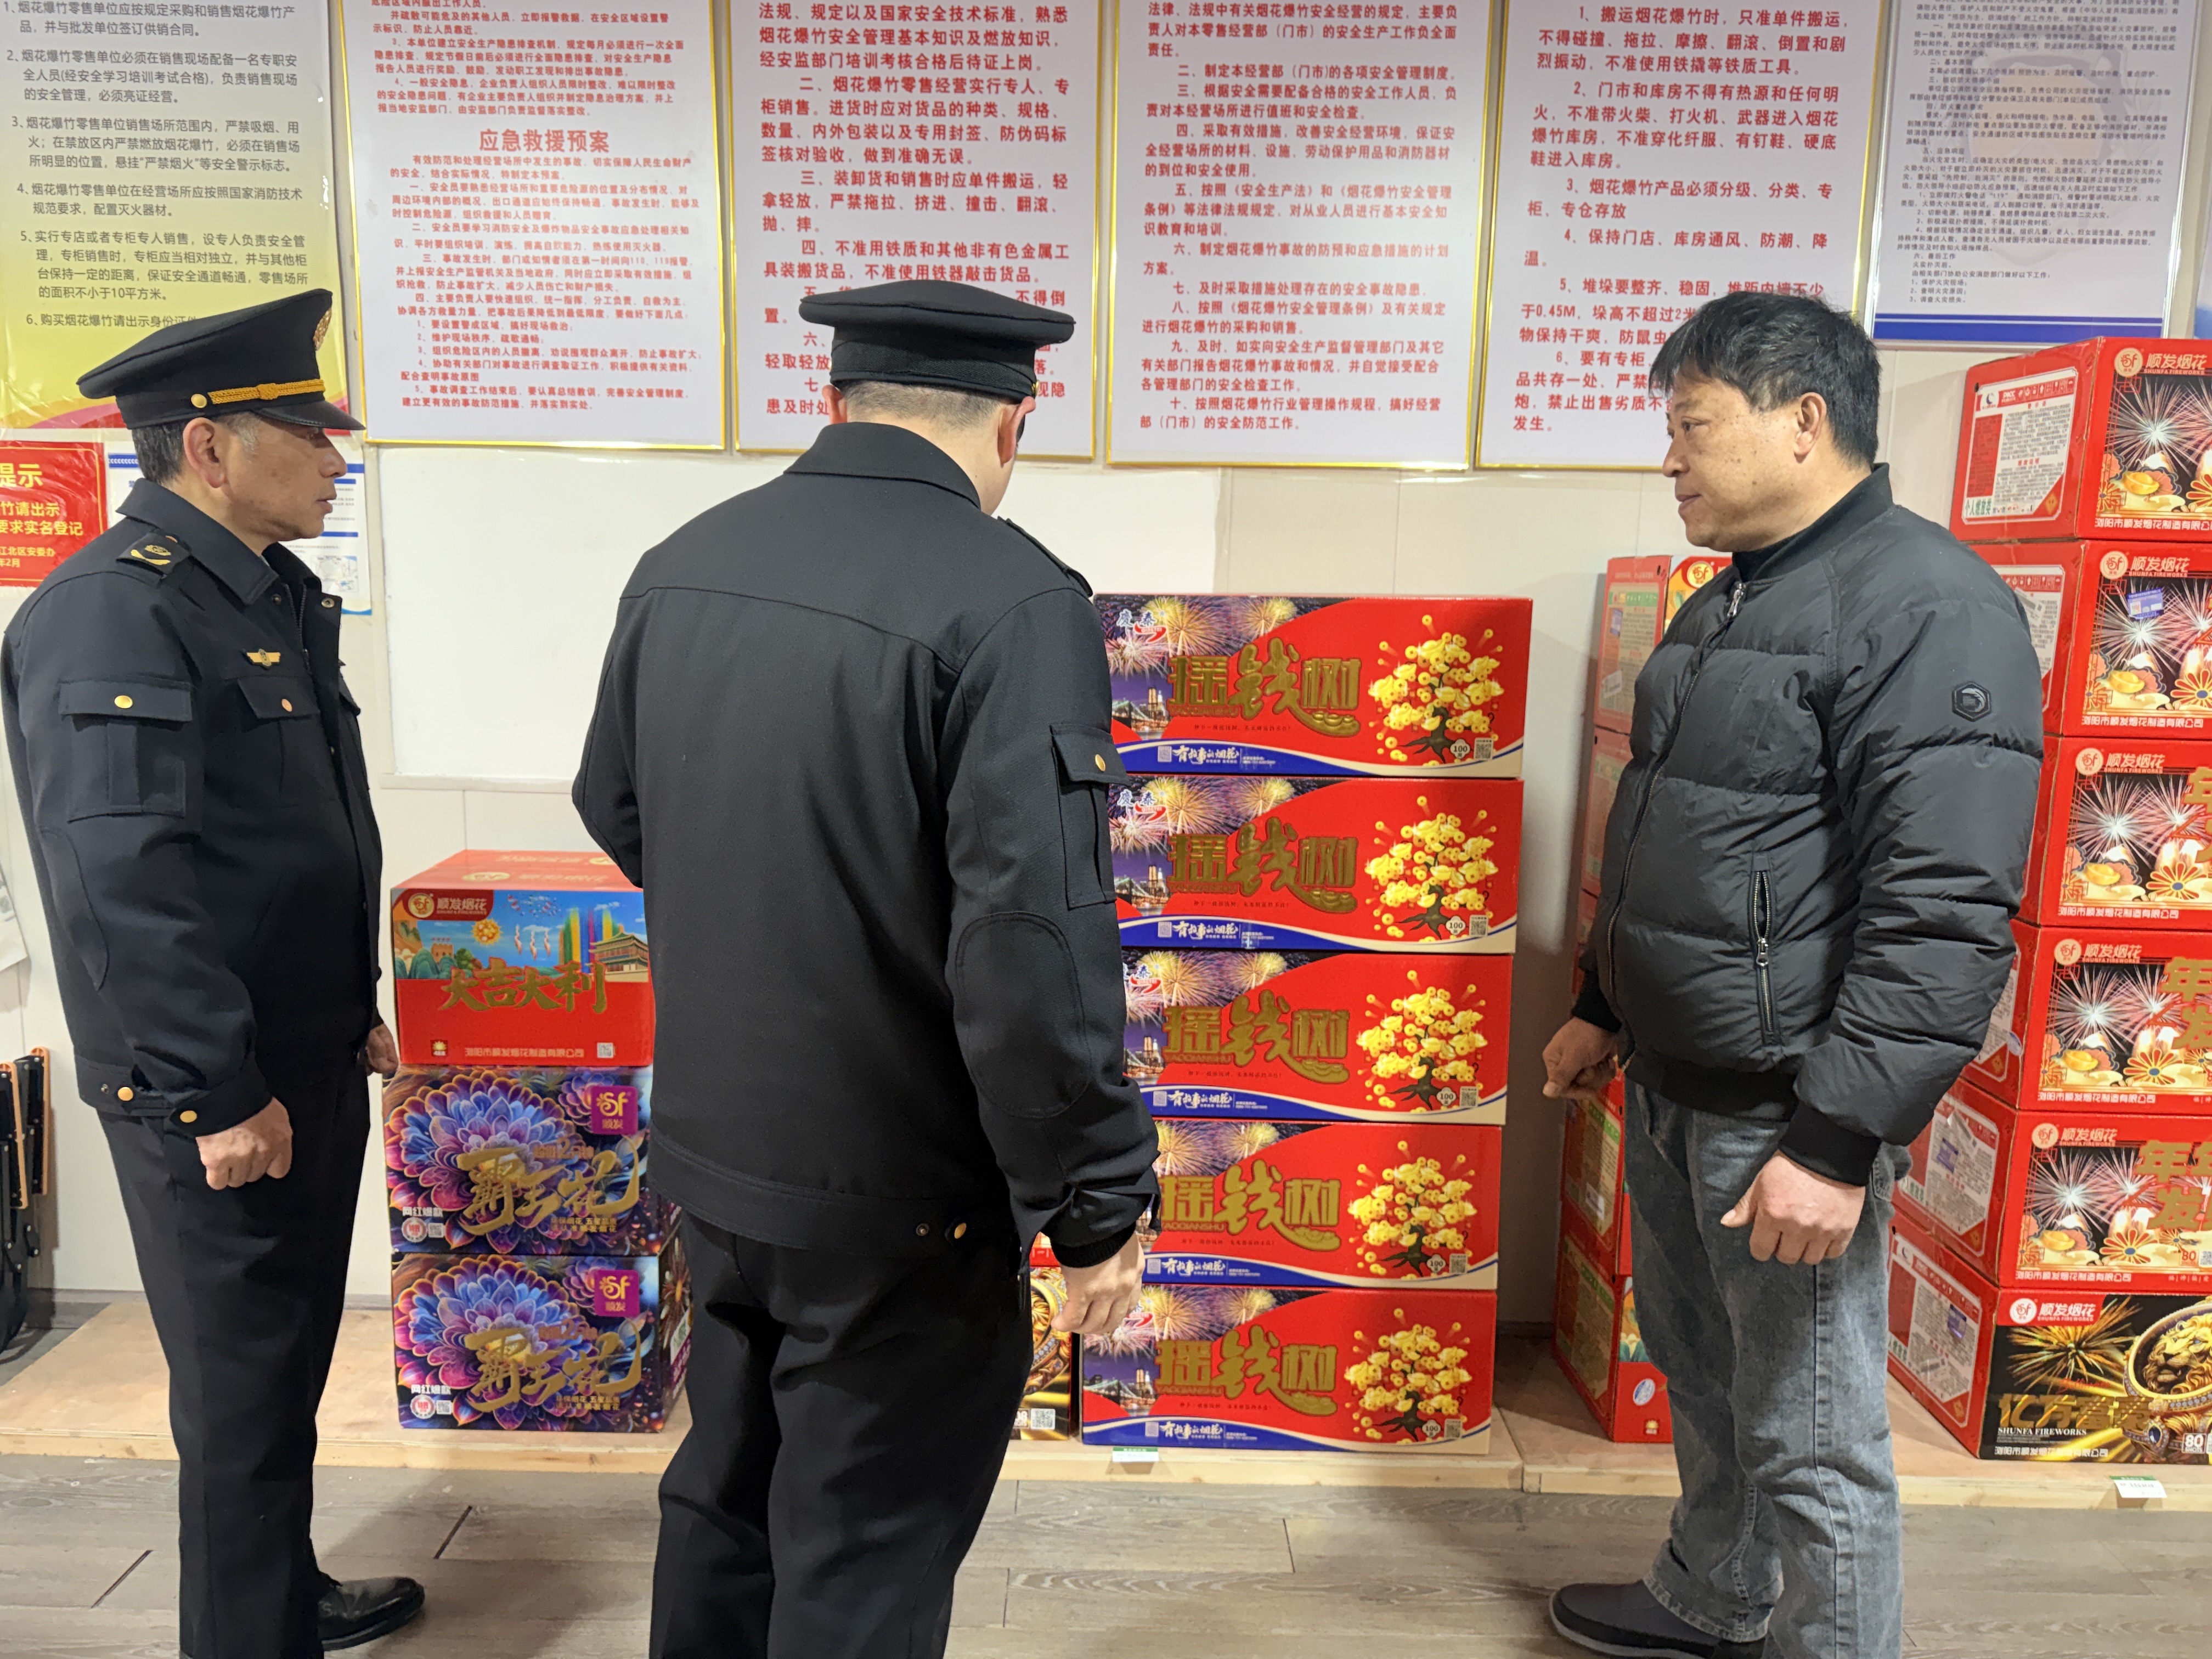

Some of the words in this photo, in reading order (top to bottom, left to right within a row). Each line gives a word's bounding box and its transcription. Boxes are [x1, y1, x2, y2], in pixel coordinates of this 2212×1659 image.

[4, 1, 295, 18] 1、烟花爆竹零售单位应按规定采购和销售烟花爆竹产
[759, 3, 1067, 22] 法规、规定以及国家安全技术标准，熟悉
[1149, 3, 1457, 19] 法律、法规中有关烟花爆竹安全经营的规定，主要负
[1579, 7, 1847, 27] 1、搬运烟花爆竹时，只准单件搬运，
[20, 20, 199, 36] 品，并与批发单位签订供销合同。
[1149, 23, 1456, 39] 责人对本零售经营部（门市）的安全生产工作负全面
[760, 28, 1057, 46] 烟花爆竹安全管理基本知识及燃放知识，
[1539, 30, 1846, 52] 不得碰撞、拖拉、摩擦、翻滚、倒置和剧
[7, 50, 297, 66] 2、烟花爆竹零售单位必须在销售现场配备一名专职安
[1148, 43, 1178, 57] 责任。
[760, 52, 1040, 70] 经安监部门培训考核合格后待证上岗。
[1537, 53, 1798, 74] 烈振动，不准使用铁撬等铁质工具。
[23, 69, 297, 85] 全人员(经安全学习培训考试合格)，负责销售现场
[799, 76, 1069, 94] 二、烟花爆竹零售经营实行专人、专
[24, 88, 177, 103] 的安全管理，必须亮证经营。
[1177, 83, 1456, 99] 三、根据安全需要配备合格的安全工作人员，负
[1574, 82, 1838, 101] 2、门市和库房不得有热源和任何明
[761, 99, 1056, 118] 柜销售。进货时应对货品的种类、规格、
[1147, 103, 1363, 119] 责对本经营场所进行值班和安全检查。
[1534, 106, 1838, 126] 火，不准带火柴、打火机、武器进入烟花
[12, 116, 299, 133] 3、烟花爆竹零售单位销售场所范围内，严禁吸烟、用
[761, 123, 1066, 142] 数量、内外包装以及专用封签、防伪码标
[1177, 123, 1454, 139] 四、采取有效措施，改善安全经营环境，保证安
[28, 137, 300, 153] 火；在禁放区内严禁燃放烟花爆竹，必须在销售场
[479, 129, 608, 152] 应急救援预案
[1532, 128, 1836, 149] 爆竹库房，不准穿化纤服、有钉鞋、硬底
[762, 146, 971, 163] 签核对验收，做到准确无误。
[1146, 144, 1449, 159] 全经营场所的材料、设施、劳动保护用品和消防器材
[1531, 151, 1620, 168] 鞋进入库房。
[30, 155, 289, 171] 所明显的位置，悬挂“严禁烟火”等安全警示标志。
[1146, 163, 1255, 177] 的到位和安全使用。
[801, 171, 1067, 189] 三、装卸货和销售时应单件搬运，轻
[17, 183, 302, 199] 4、烟花爆竹零售单位在经营场所应按照国家消防技术
[1567, 179, 1832, 198] 3、烟花爆竹产品必须分级、分类、专
[33, 202, 172, 216] 规范要求，配置灭火器材。
[1528, 201, 1626, 218] 柜、专仓存放
[763, 216, 819, 232] 抛、摔。
[1144, 222, 1226, 236] 识教育和培训。
[21, 230, 304, 247] 5、实行专店或者专柜专人销售，设专人负责安全管
[1565, 229, 1827, 248] 4、保持门店、库房通风、防潮、降
[36, 249, 307, 266] 理，专柜销售时，专柜应当相对独立，并与其他柜
[802, 240, 1069, 259] 四、不准用铁质和其他非有色金属工
[1524, 251, 1545, 266] 温。
[38, 268, 308, 284] 台保持一定的距离，保证安全通道畅通，零售场所
[764, 263, 1038, 284] 具装搬货品，不准使用铁器敲击货品。
[1144, 262, 1172, 275] 方案。
[38, 286, 166, 300] 的面积不小于10平方米。
[1173, 281, 1419, 296] 七、及时采取措施处理存在的安全事故隐患。
[765, 308, 786, 323] 置。
[1142, 320, 1301, 334] 进行烟花爆竹的采购和销售。
[1519, 328, 1675, 345] 物保持干爽，防鼠虫
[1172, 340, 1443, 354] 九、及时、如实向安全生产监督管理部门及其它
[765, 354, 830, 370] 轻取轻放
[1142, 359, 1438, 373] 有关部门报告烟花爆竹事故和情况，并自觉接受配合
[2146, 353, 2208, 370] 顺发烟花
[1141, 377, 1299, 391] 各管理部门的安全检查工作。
[1516, 372, 1656, 390] 品共存一处、严禁
[1170, 397, 1440, 411] 十、按照烟花爆竹行业管理操作规程，搞好经营
[1141, 416, 1298, 429] 部（门市）的安全防范工作。
[1513, 415, 1551, 431] 发生。
[0, 501, 60, 517] 竹请出示
[0, 520, 83, 536] 要求实名登记
[2130, 556, 2191, 572] 顺发烟花
[1168, 637, 1362, 737] 摇钱树
[2081, 715, 2204, 729] 浏阳市顺发烟花制造有限公司
[2106, 753, 2165, 769] 顺发烟花
[1168, 817, 1358, 913] 摇钱树
[437, 898, 487, 910] 顺发烟花
[2058, 907, 2180, 919] 浏阳市顺发烟花制造有限公司
[1449, 922, 1463, 930] 100
[2085, 944, 2142, 958] 顺发烟花
[440, 957, 607, 1014] 大吉大利
[1163, 989, 1350, 1085] 摇钱树
[1438, 1093, 1454, 1101] 100
[2037, 1092, 2156, 1104] 浏阳市顺发烟花制造有限公司
[2061, 1128, 2118, 1142] 顺发烟花
[1159, 1159, 1342, 1252] 摇钱树
[1429, 1260, 1444, 1268] 100
[2181, 1251, 2197, 1261] 80
[2039, 1302, 2097, 1317] 顺发烟花
[1154, 1324, 1338, 1417] 摇钱树
[1997, 1427, 2033, 1435] SHUNFA
[2035, 1427, 2087, 1436] FIREWORKS
[2185, 1435, 2203, 1446] 80
